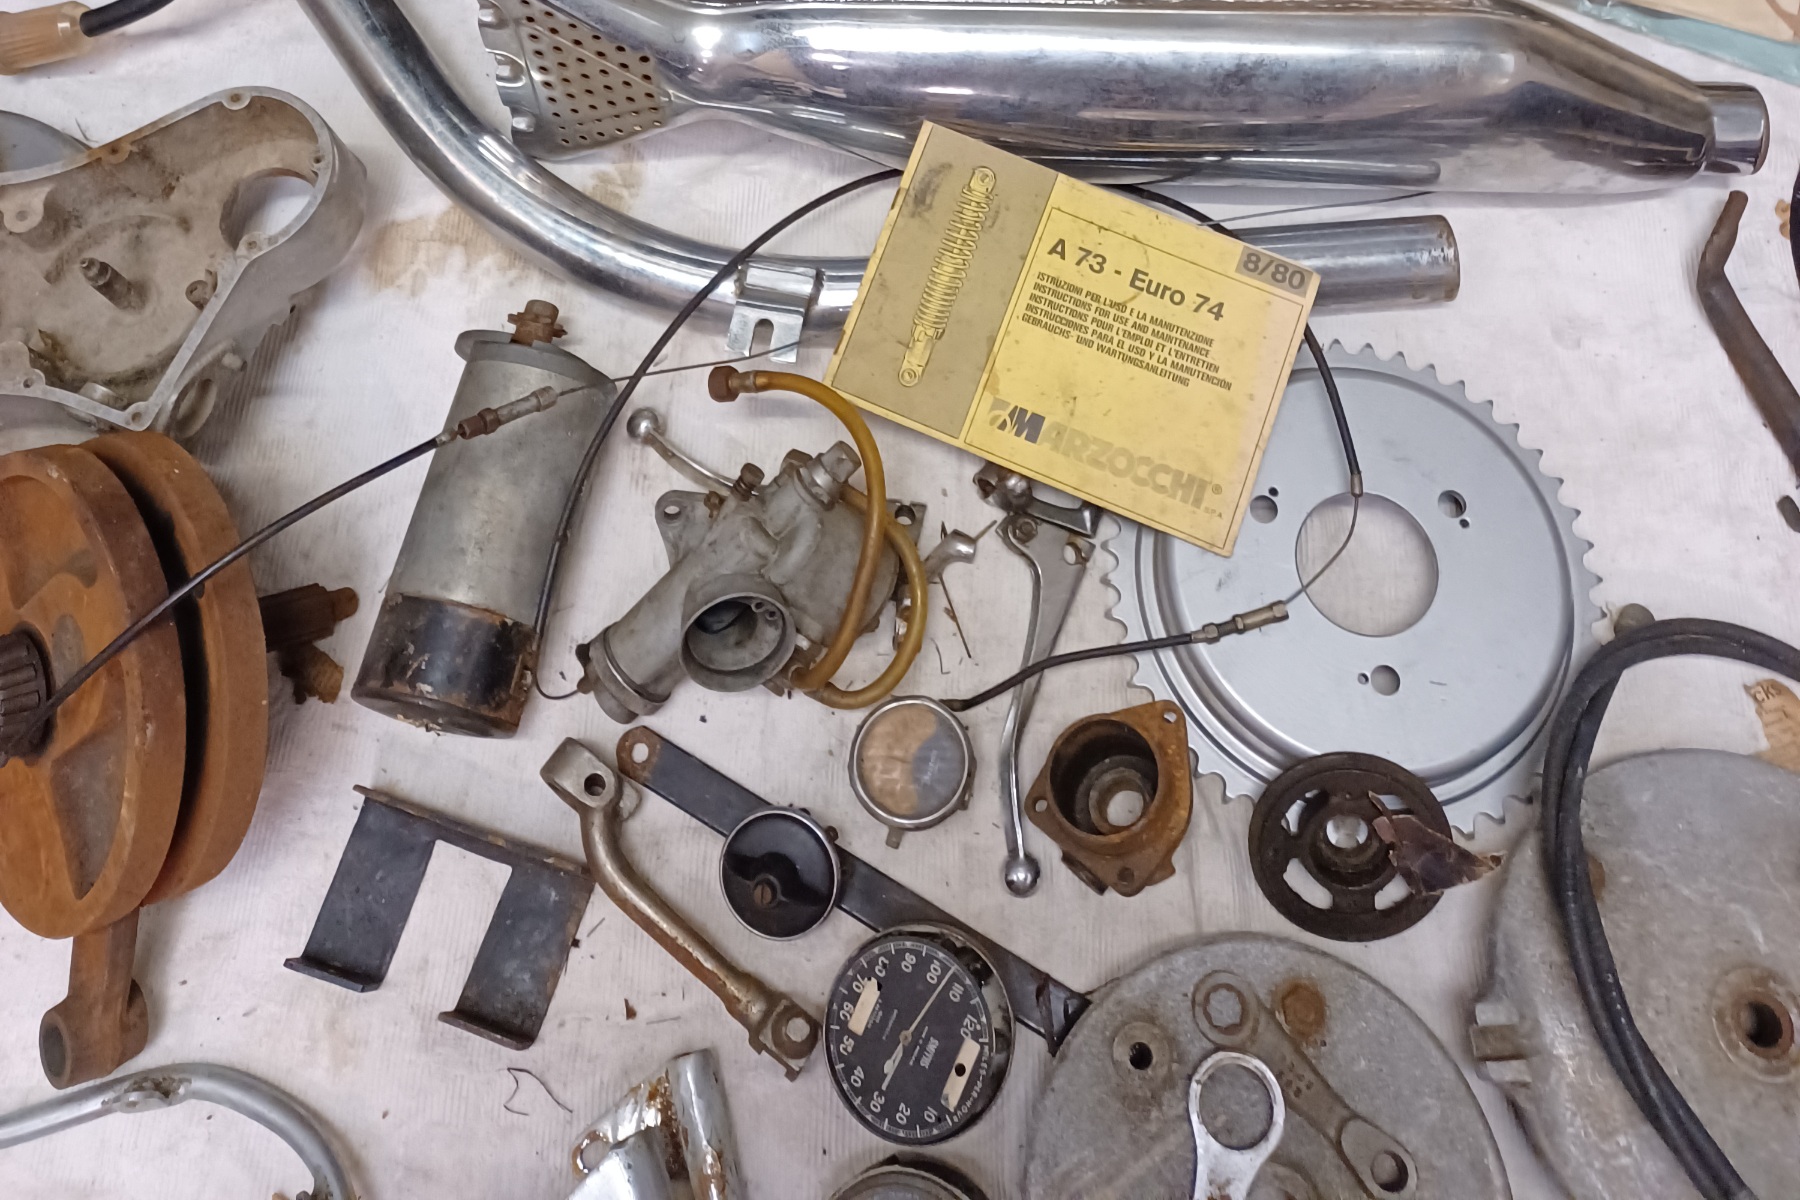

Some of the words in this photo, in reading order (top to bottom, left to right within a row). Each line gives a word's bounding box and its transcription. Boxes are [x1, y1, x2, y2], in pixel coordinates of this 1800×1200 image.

[1048, 237, 1067, 261] A
[1074, 246, 1108, 275] 73
[1128, 268, 1190, 307] Euro
[1191, 293, 1226, 322] 74
[1242, 251, 1307, 290] 8/80
[1032, 282, 1093, 312] INSTRUCTIONS
[1094, 306, 1112, 319] FOR
[1112, 313, 1130, 326] USE
[1131, 321, 1150, 334] AND
[1150, 328, 1211, 358] MAINTENANCE
[1036, 271, 1084, 296] ISTRUZIONI
[1084, 290, 1102, 303] PER
[1129, 308, 1135, 316] E
[1136, 310, 1149, 321] LA
[1148, 315, 1215, 348] MANUTENZIONE
[1025, 303, 1090, 335] INSTRUCCIONES
[1090, 329, 1116, 345] PARA
[1116, 339, 1127, 349] EL
[1127, 343, 1147, 357] USO
[1147, 351, 1156, 360] Y
[1156, 355, 1169, 366] LA
[1170, 360, 1233, 391] MANUTENCIÓN
[1028, 292, 1089, 322] INSTRUCTIONS
[1090, 317, 1115, 332] POUR
[1115, 327, 1155, 348] L'EMPLOI
[1155, 342, 1166, 353] ET
[1167, 347, 1220, 374] L'ENTRETIEN
[1095, 343, 1191, 387] WARTUNGSANLEITUNG
[901, 952, 916, 973] 90
[852, 974, 867, 993] 70
[949, 982, 964, 1002] 110
[851, 1066, 865, 1087] 40
[870, 1091, 885, 1113] 30
[896, 1103, 910, 1125] 20
[924, 1106, 938, 1123] 10
